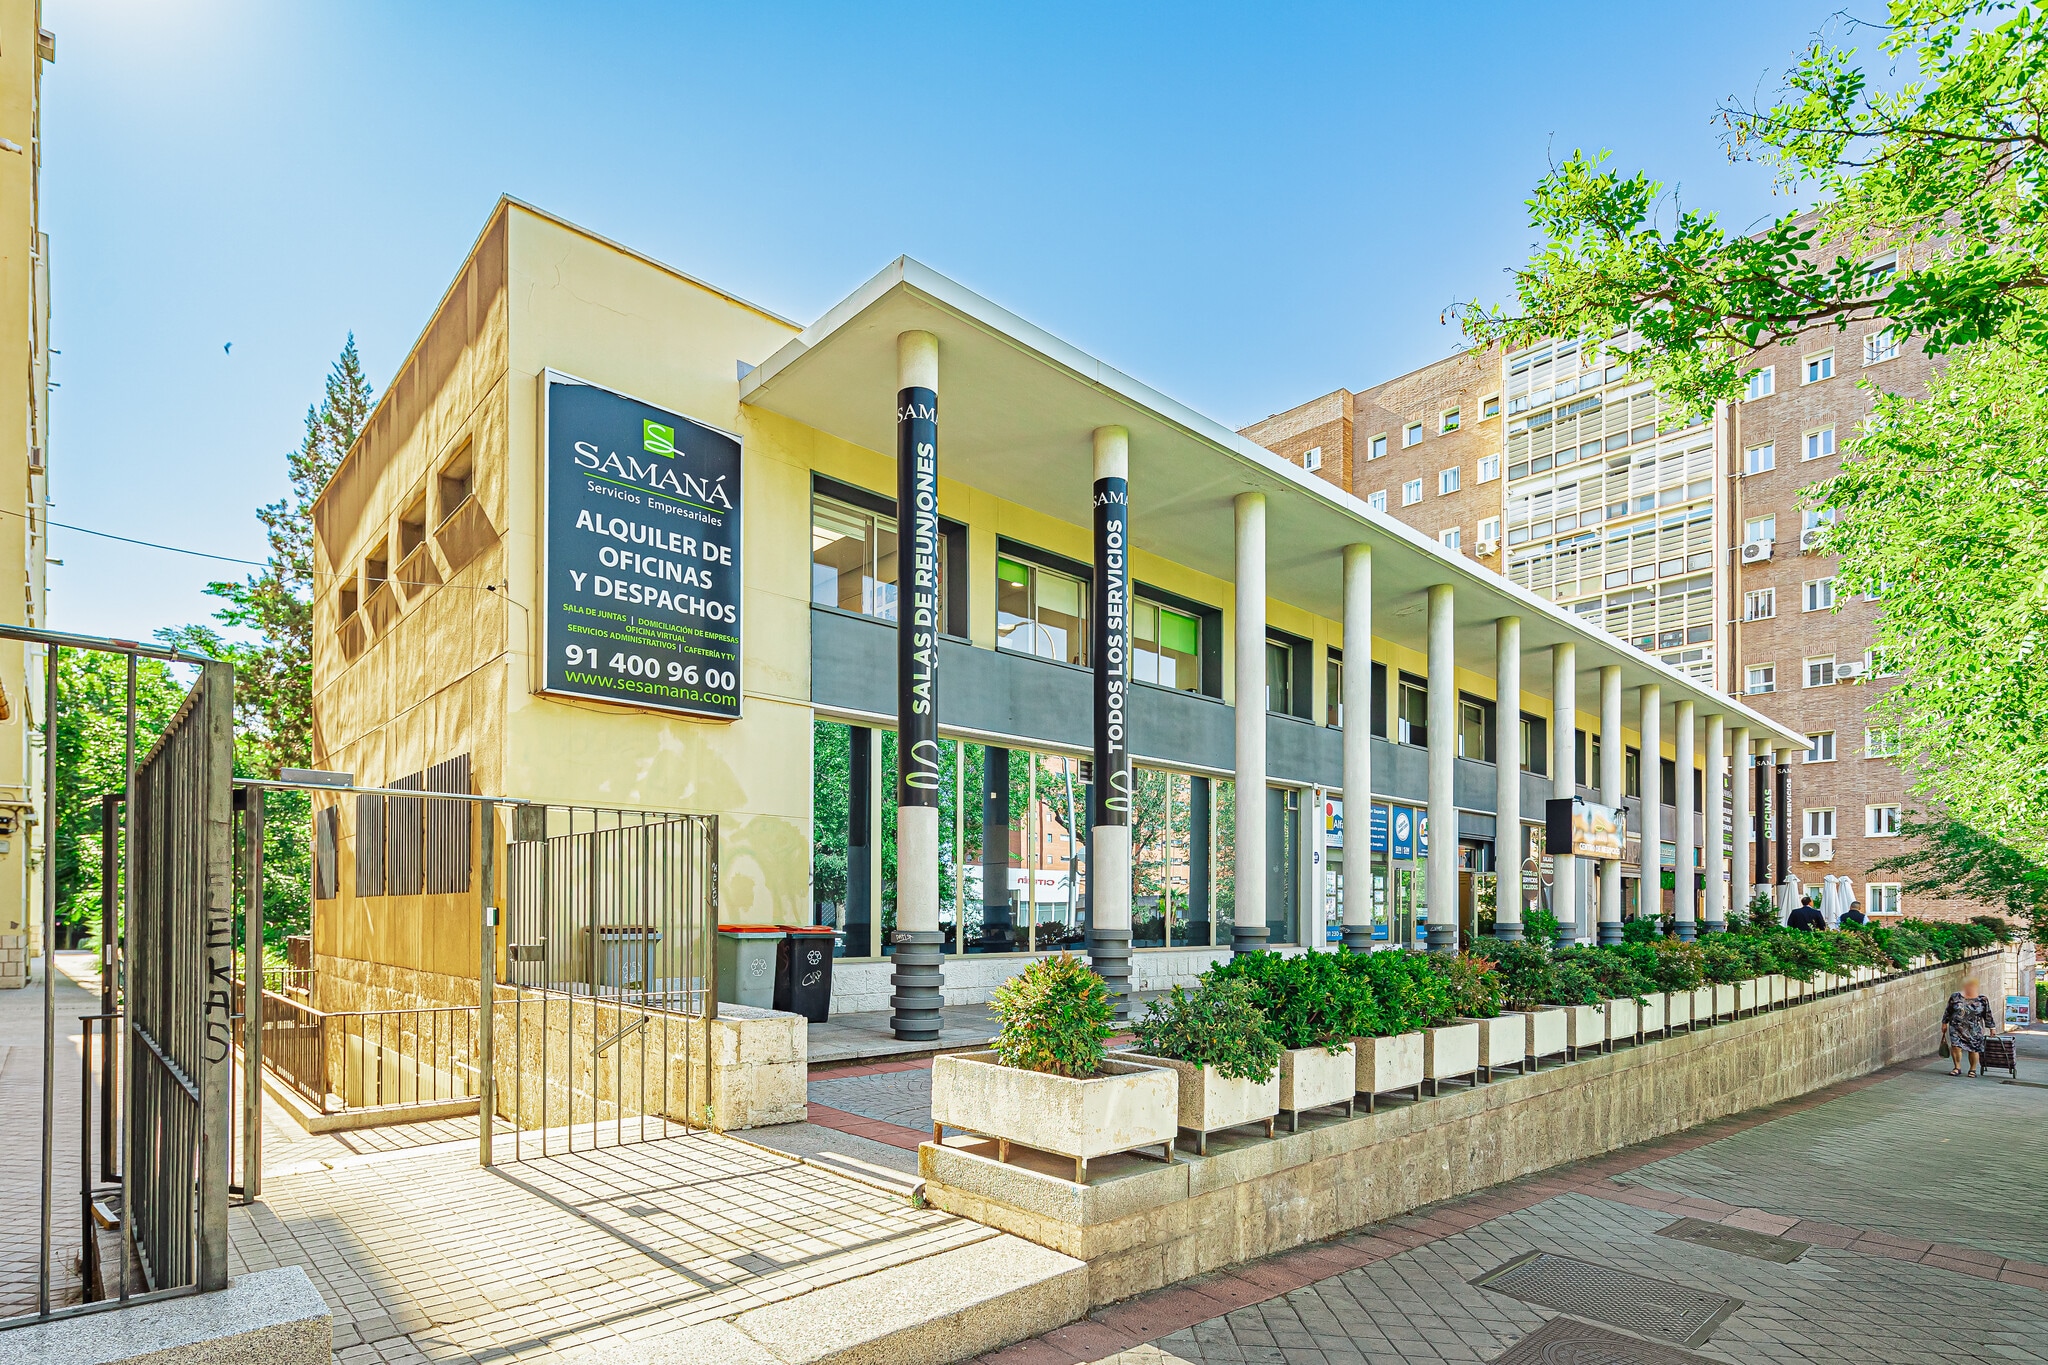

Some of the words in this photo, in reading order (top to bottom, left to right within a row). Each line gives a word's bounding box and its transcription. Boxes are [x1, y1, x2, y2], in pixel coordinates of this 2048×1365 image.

[574, 441, 733, 509] SAMANÁ
[587, 481, 641, 504] Servicios
[648, 497, 722, 527] Empresariales
[915, 442, 934, 587] REUNIONES
[575, 509, 697, 557] ALQUILER
[702, 541, 732, 566] DE
[598, 546, 713, 590] OFICINAS
[1107, 520, 1123, 629] SERVICIOS
[569, 570, 588, 591] Y
[594, 575, 736, 624] DESPACHOS
[914, 592, 932, 627] DE
[562, 603, 584, 614] SALA
[585, 607, 596, 616] DE
[597, 610, 627, 622] JUNTAS
[638, 618, 693, 635] DOMICILIACIÓN
[694, 629, 704, 637] DE
[704, 631, 739, 644] EMPRESAS
[567, 623, 609, 638] SERVICIOS
[609, 632, 677, 650] ADMINISTRATIVOS
[683, 645, 721, 659] CAFETERÍA
[725, 653, 736, 661] TV
[625, 625, 656, 638] OFICINA
[656, 631, 686, 643] VIRTUAL
[565, 644, 598, 669] 91
[609, 652, 661, 679] 400
[666, 661, 699, 685] 96
[705, 668, 736, 691] 00
[912, 633, 931, 715] SALAS
[1108, 635, 1123, 675] LOS
[564, 670, 737, 707] www.sesamana.com
[1108, 681, 1123, 754] TODOS
[1764, 789, 1772, 839] OFICINAS
